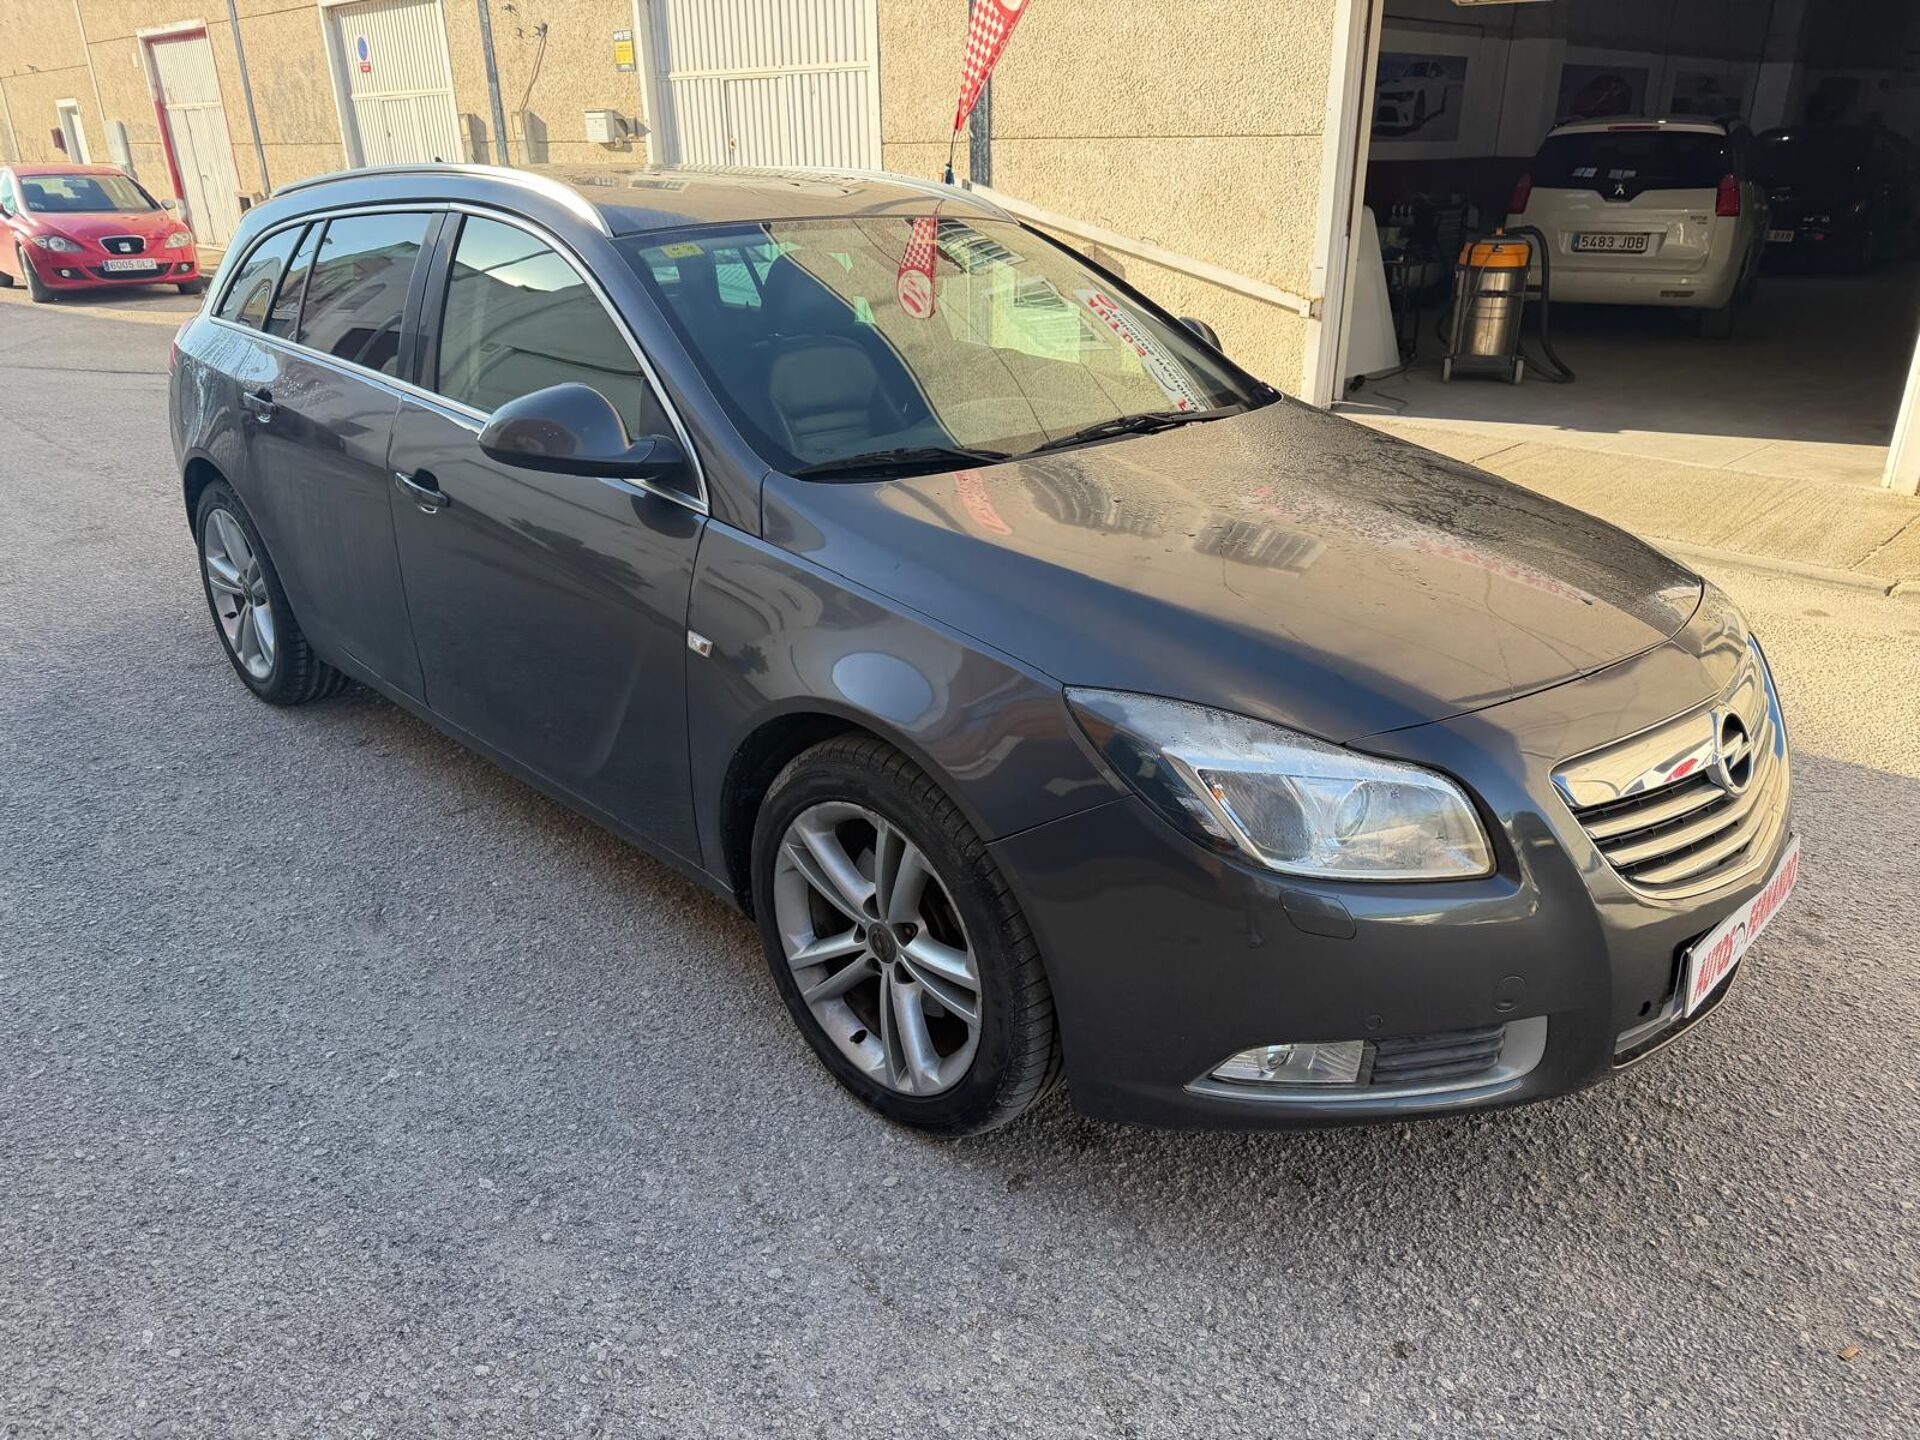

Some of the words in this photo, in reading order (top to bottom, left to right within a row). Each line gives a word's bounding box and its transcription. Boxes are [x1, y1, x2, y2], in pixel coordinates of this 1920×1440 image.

[1582, 235, 1615, 248] 5483
[1619, 236, 1645, 249] JDB
[1692, 924, 1738, 1002] AUTOS
